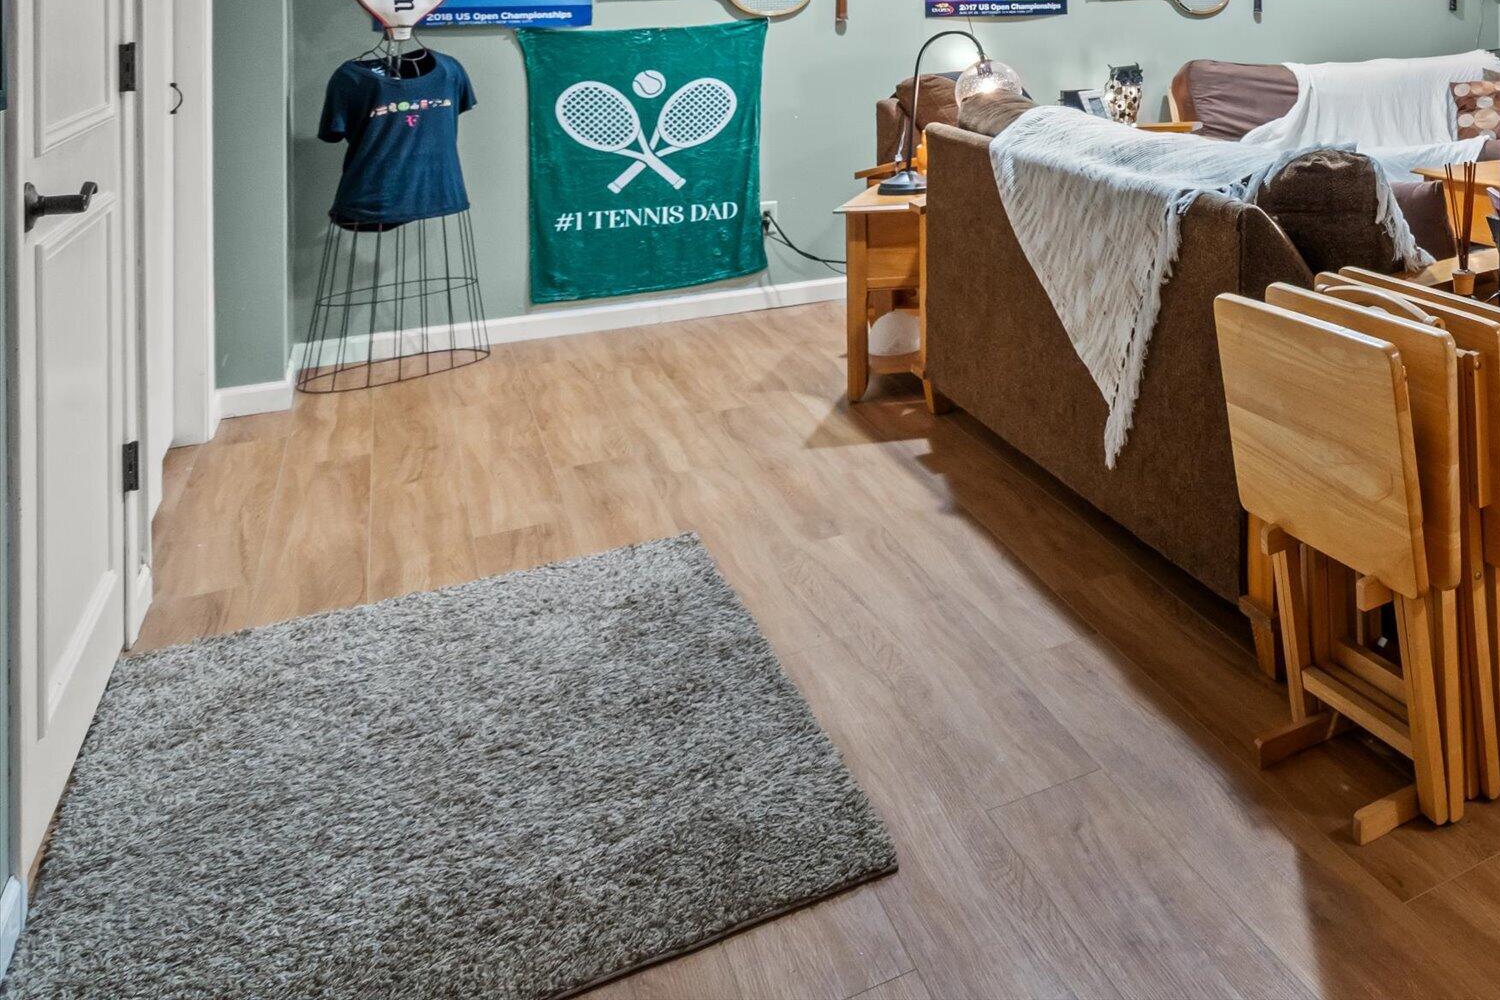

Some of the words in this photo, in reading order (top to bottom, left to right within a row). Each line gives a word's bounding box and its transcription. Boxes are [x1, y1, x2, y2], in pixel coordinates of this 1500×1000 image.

[990, 3, 1010, 11] Open
[1010, 2, 1061, 11] Championships
[426, 13, 453, 21] 2018
[455, 12, 471, 21] US
[473, 12, 499, 21] Open
[500, 11, 573, 20] Championships
[554, 211, 583, 232] #1
[587, 204, 685, 230] TENNIS
[690, 201, 739, 222] DAD
